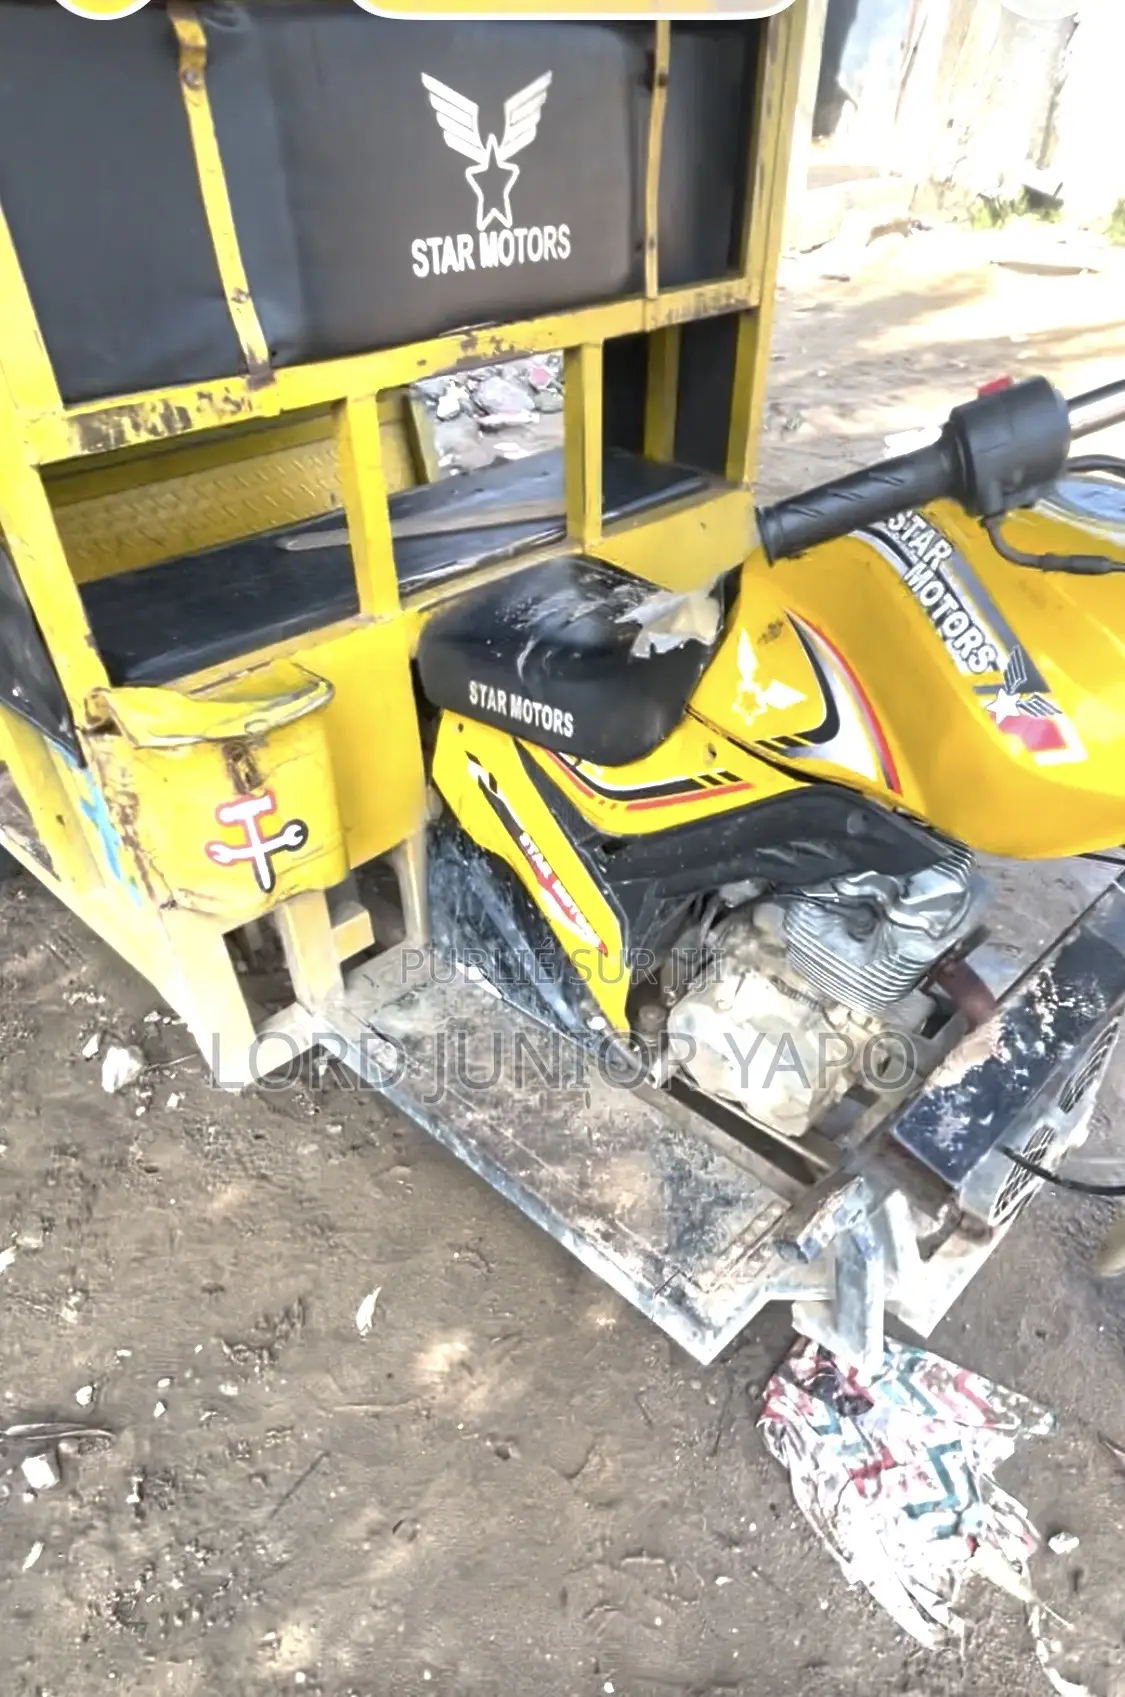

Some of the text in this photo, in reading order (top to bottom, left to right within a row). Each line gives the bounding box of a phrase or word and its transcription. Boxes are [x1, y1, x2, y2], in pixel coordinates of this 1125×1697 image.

[411, 224, 571, 278] STAR MOTORS
[887, 510, 999, 675] STAR MOTORS
[468, 680, 575, 738] STAR MOTORS
